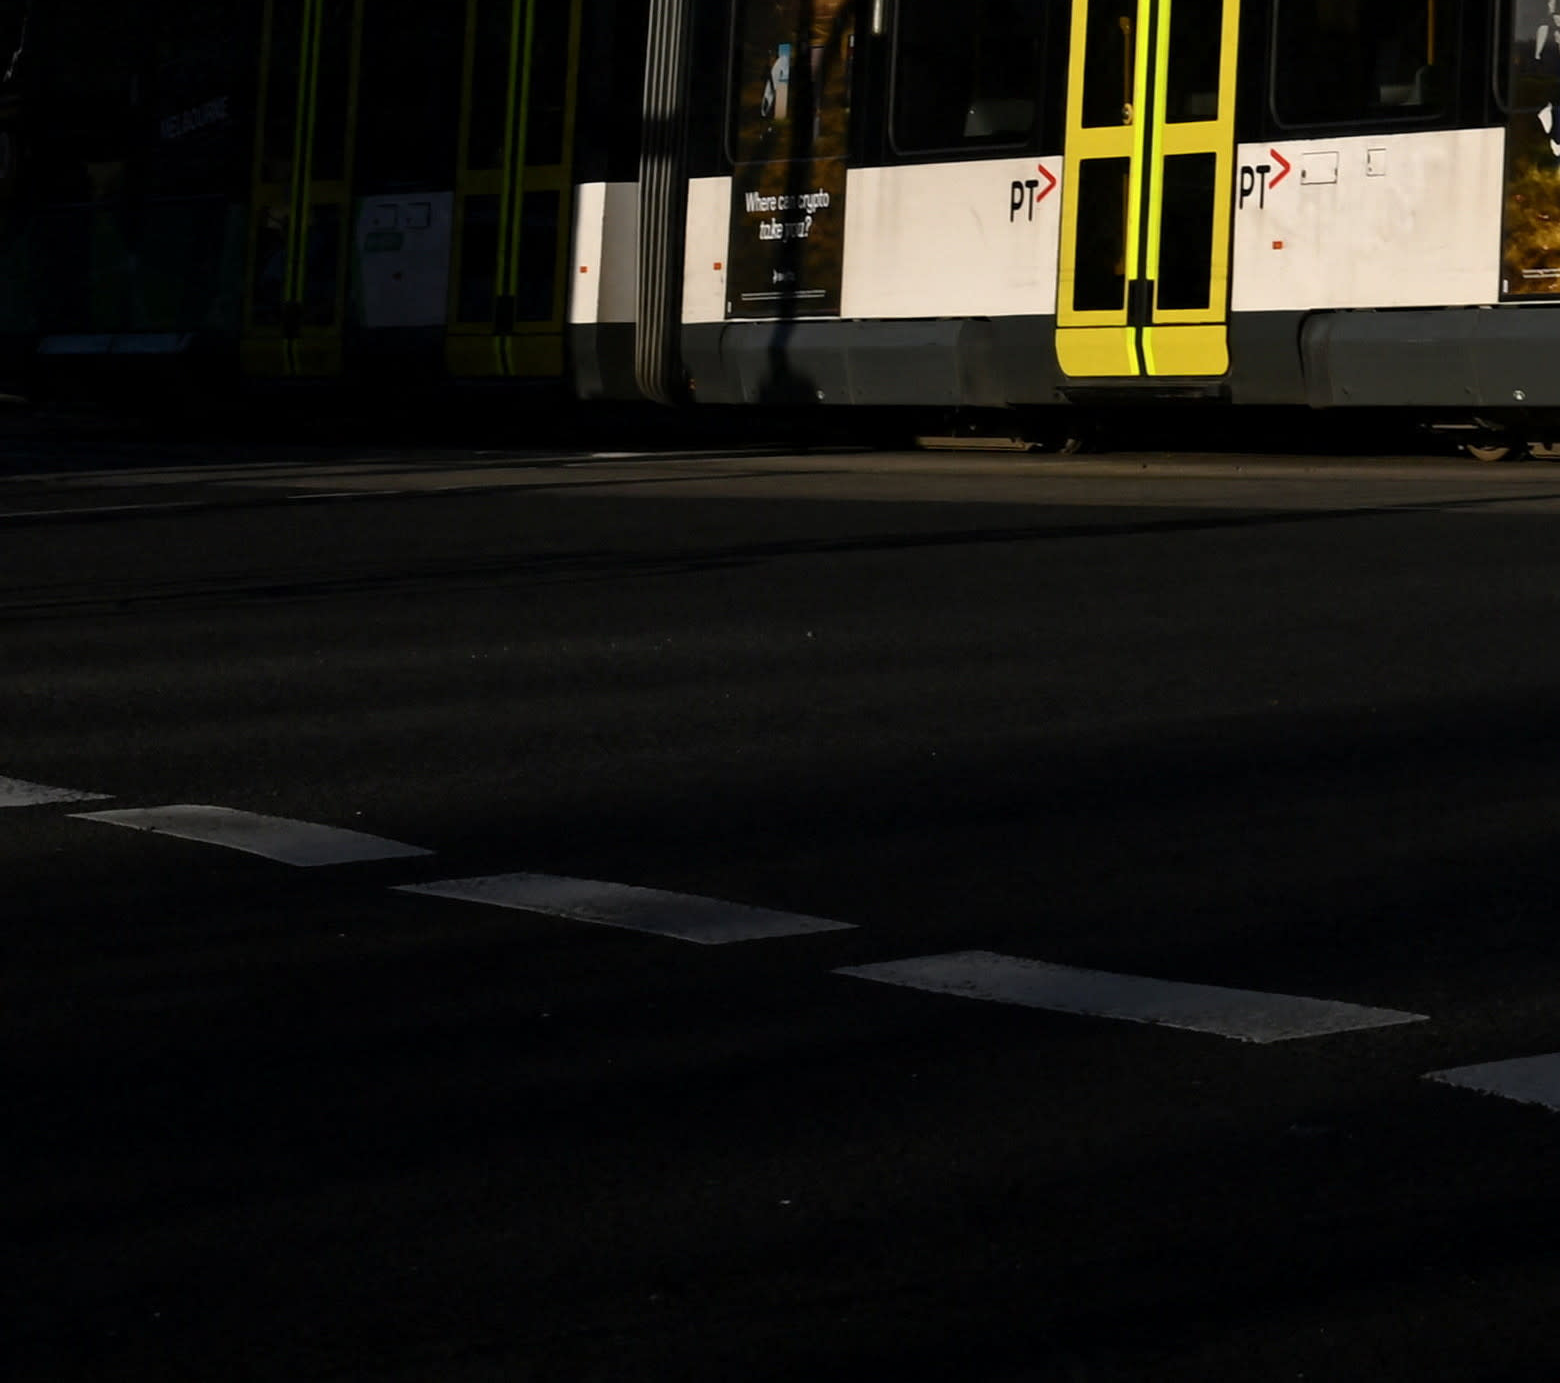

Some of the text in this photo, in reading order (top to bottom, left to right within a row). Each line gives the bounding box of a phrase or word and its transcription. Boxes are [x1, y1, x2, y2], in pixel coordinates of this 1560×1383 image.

[744, 190, 777, 213] Where
[797, 187, 831, 215] crypto
[758, 217, 784, 241] take
